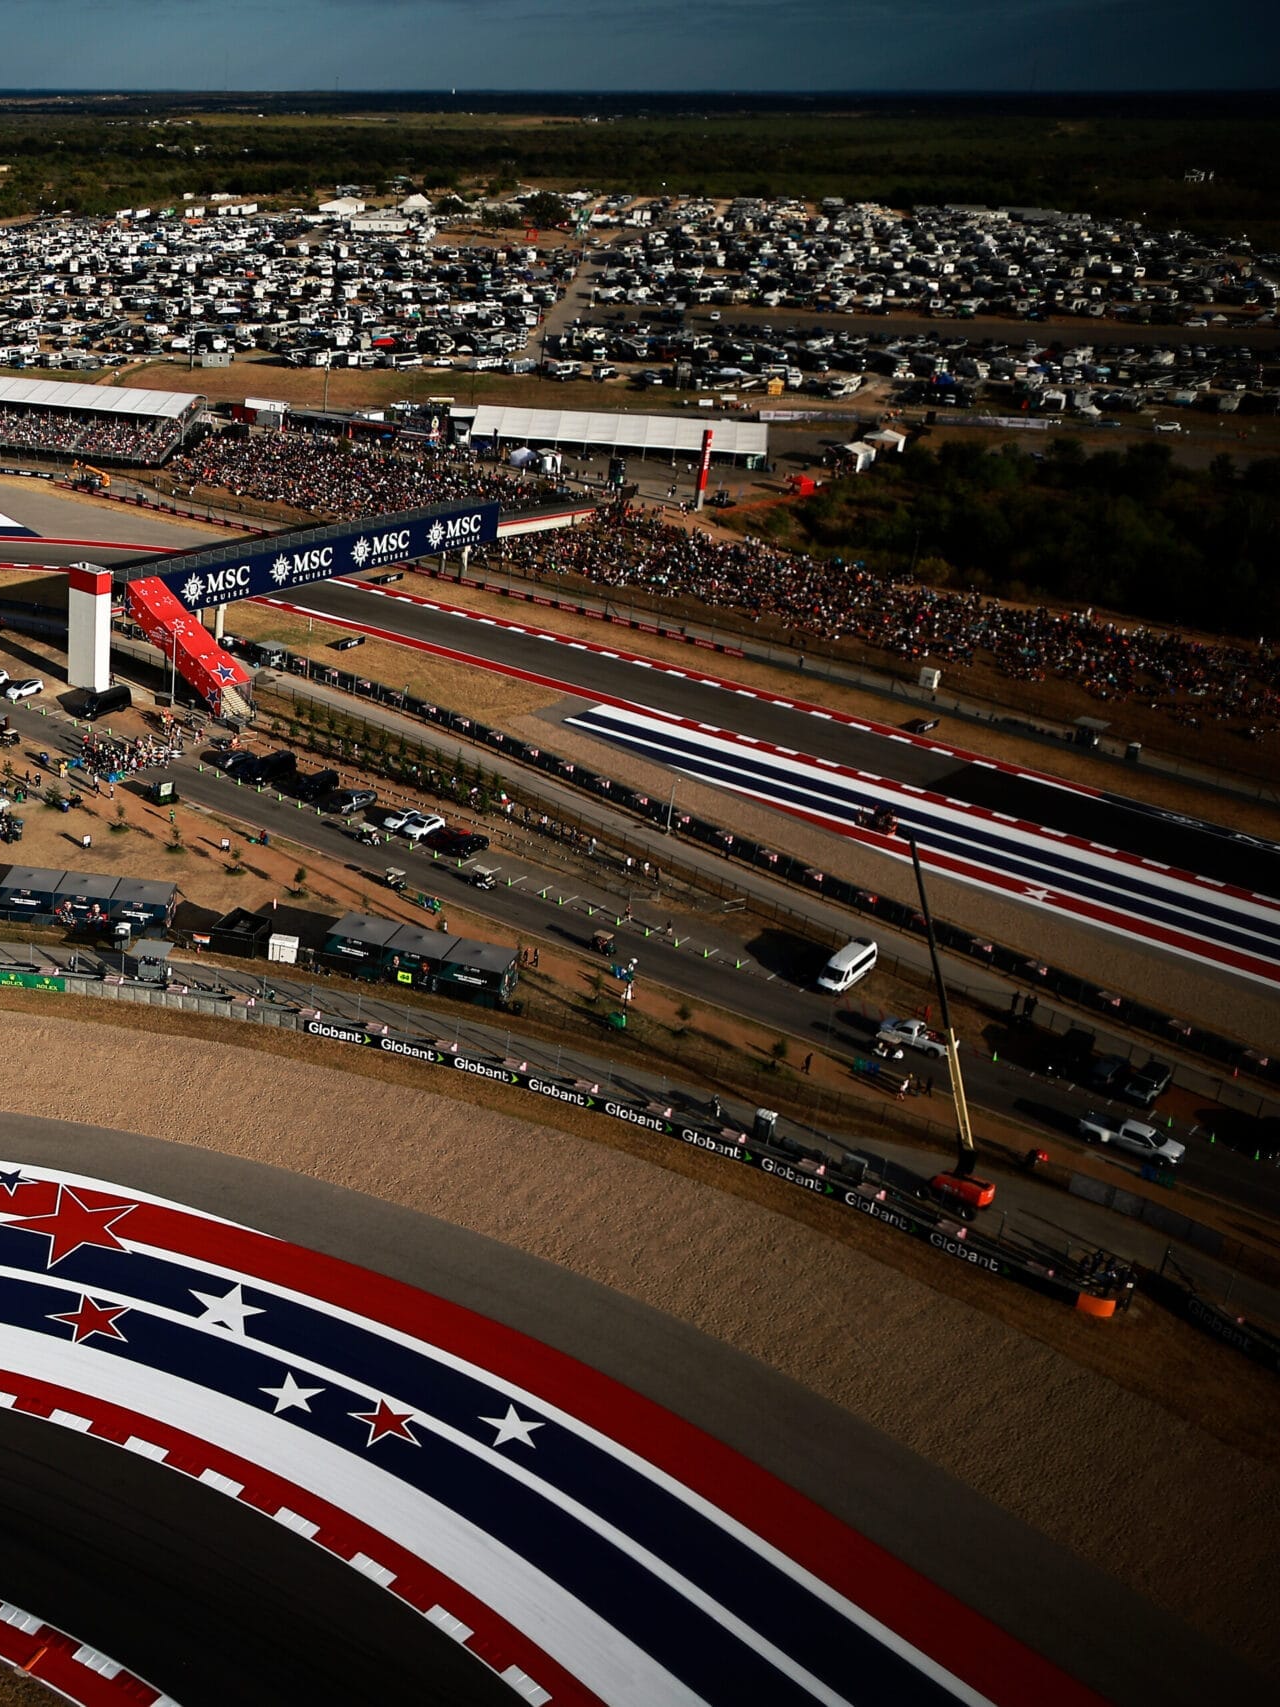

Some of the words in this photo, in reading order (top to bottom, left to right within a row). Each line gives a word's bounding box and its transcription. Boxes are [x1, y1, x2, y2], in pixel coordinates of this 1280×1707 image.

[446, 515, 482, 538] MSC
[372, 530, 410, 556] MSC
[445, 534, 480, 548] CRUISES
[292, 547, 333, 574] MSC
[371, 550, 409, 565] CRUISES
[207, 566, 250, 593] MSC
[292, 568, 332, 583] CRUISES
[206, 588, 250, 603] CRUISES
[308, 1021, 362, 1044] Globant
[381, 1038, 435, 1062] Globant
[454, 1057, 509, 1082] Globant
[529, 1079, 585, 1106] Globant
[605, 1102, 662, 1132] Globant
[682, 1129, 741, 1159] Globant
[761, 1157, 822, 1193] Globant
[845, 1191, 908, 1231] Globant
[930, 1233, 998, 1273] Globant
